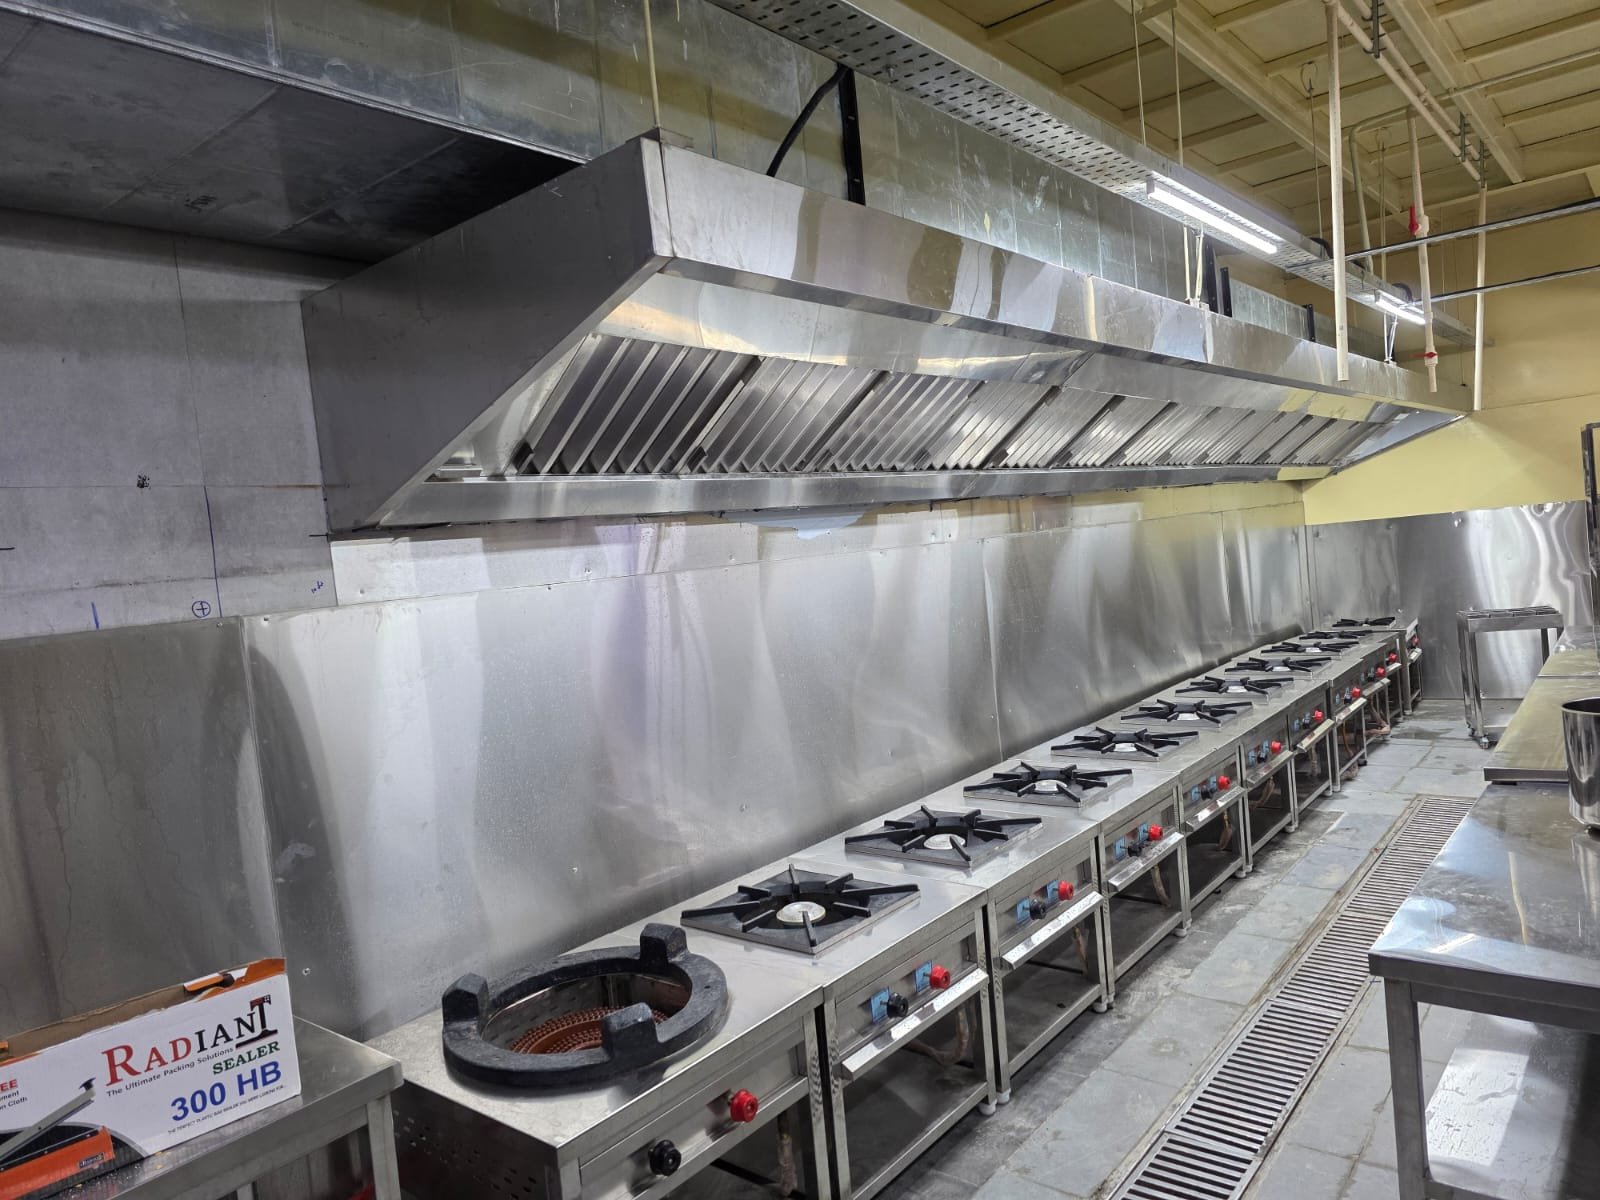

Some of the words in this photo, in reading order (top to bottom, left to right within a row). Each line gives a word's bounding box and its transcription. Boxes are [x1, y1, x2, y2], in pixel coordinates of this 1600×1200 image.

[101, 996, 278, 1087] RADIANT
[212, 1041, 280, 1075] SEALER
[106, 1088, 123, 1098] The
[125, 1073, 161, 1090] Ultimate
[163, 1062, 195, 1077] Packing
[197, 1047, 234, 1064] Solutions
[171, 1082, 226, 1121] 300
[236, 1061, 282, 1097] HB
